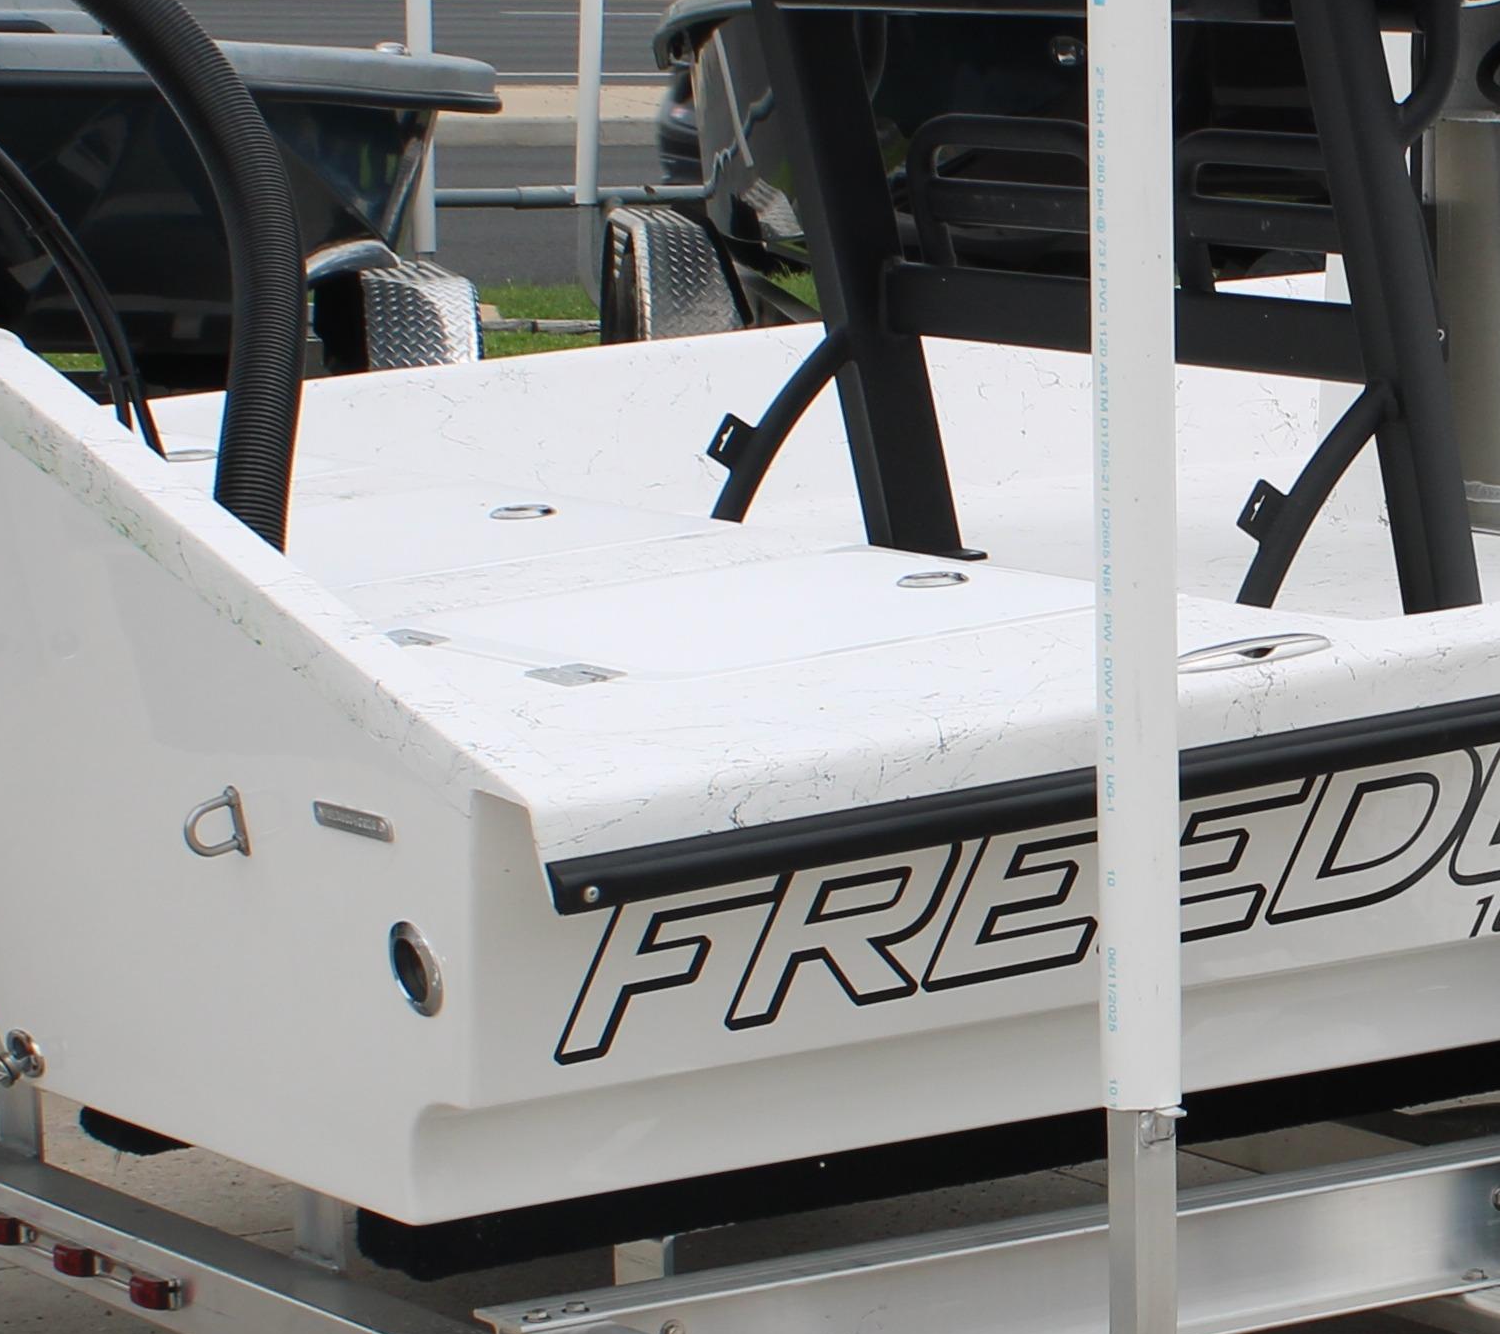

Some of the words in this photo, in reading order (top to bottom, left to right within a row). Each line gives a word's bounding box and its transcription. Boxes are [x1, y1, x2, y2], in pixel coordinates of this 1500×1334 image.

[1096, 88, 1105, 124] SCH
[1096, 129, 1105, 149] 40
[1097, 154, 1105, 183] 280
[1096, 188, 1105, 210] psi
[1099, 277, 1108, 313] PVC
[1099, 320, 1108, 357] 1120
[1100, 363, 1109, 412] ASTM
[1103, 563, 1112, 597] NSF
[1103, 613, 1113, 643] PW
[1103, 657, 1114, 699] DWV
[1106, 774, 1116, 812] UG-1
